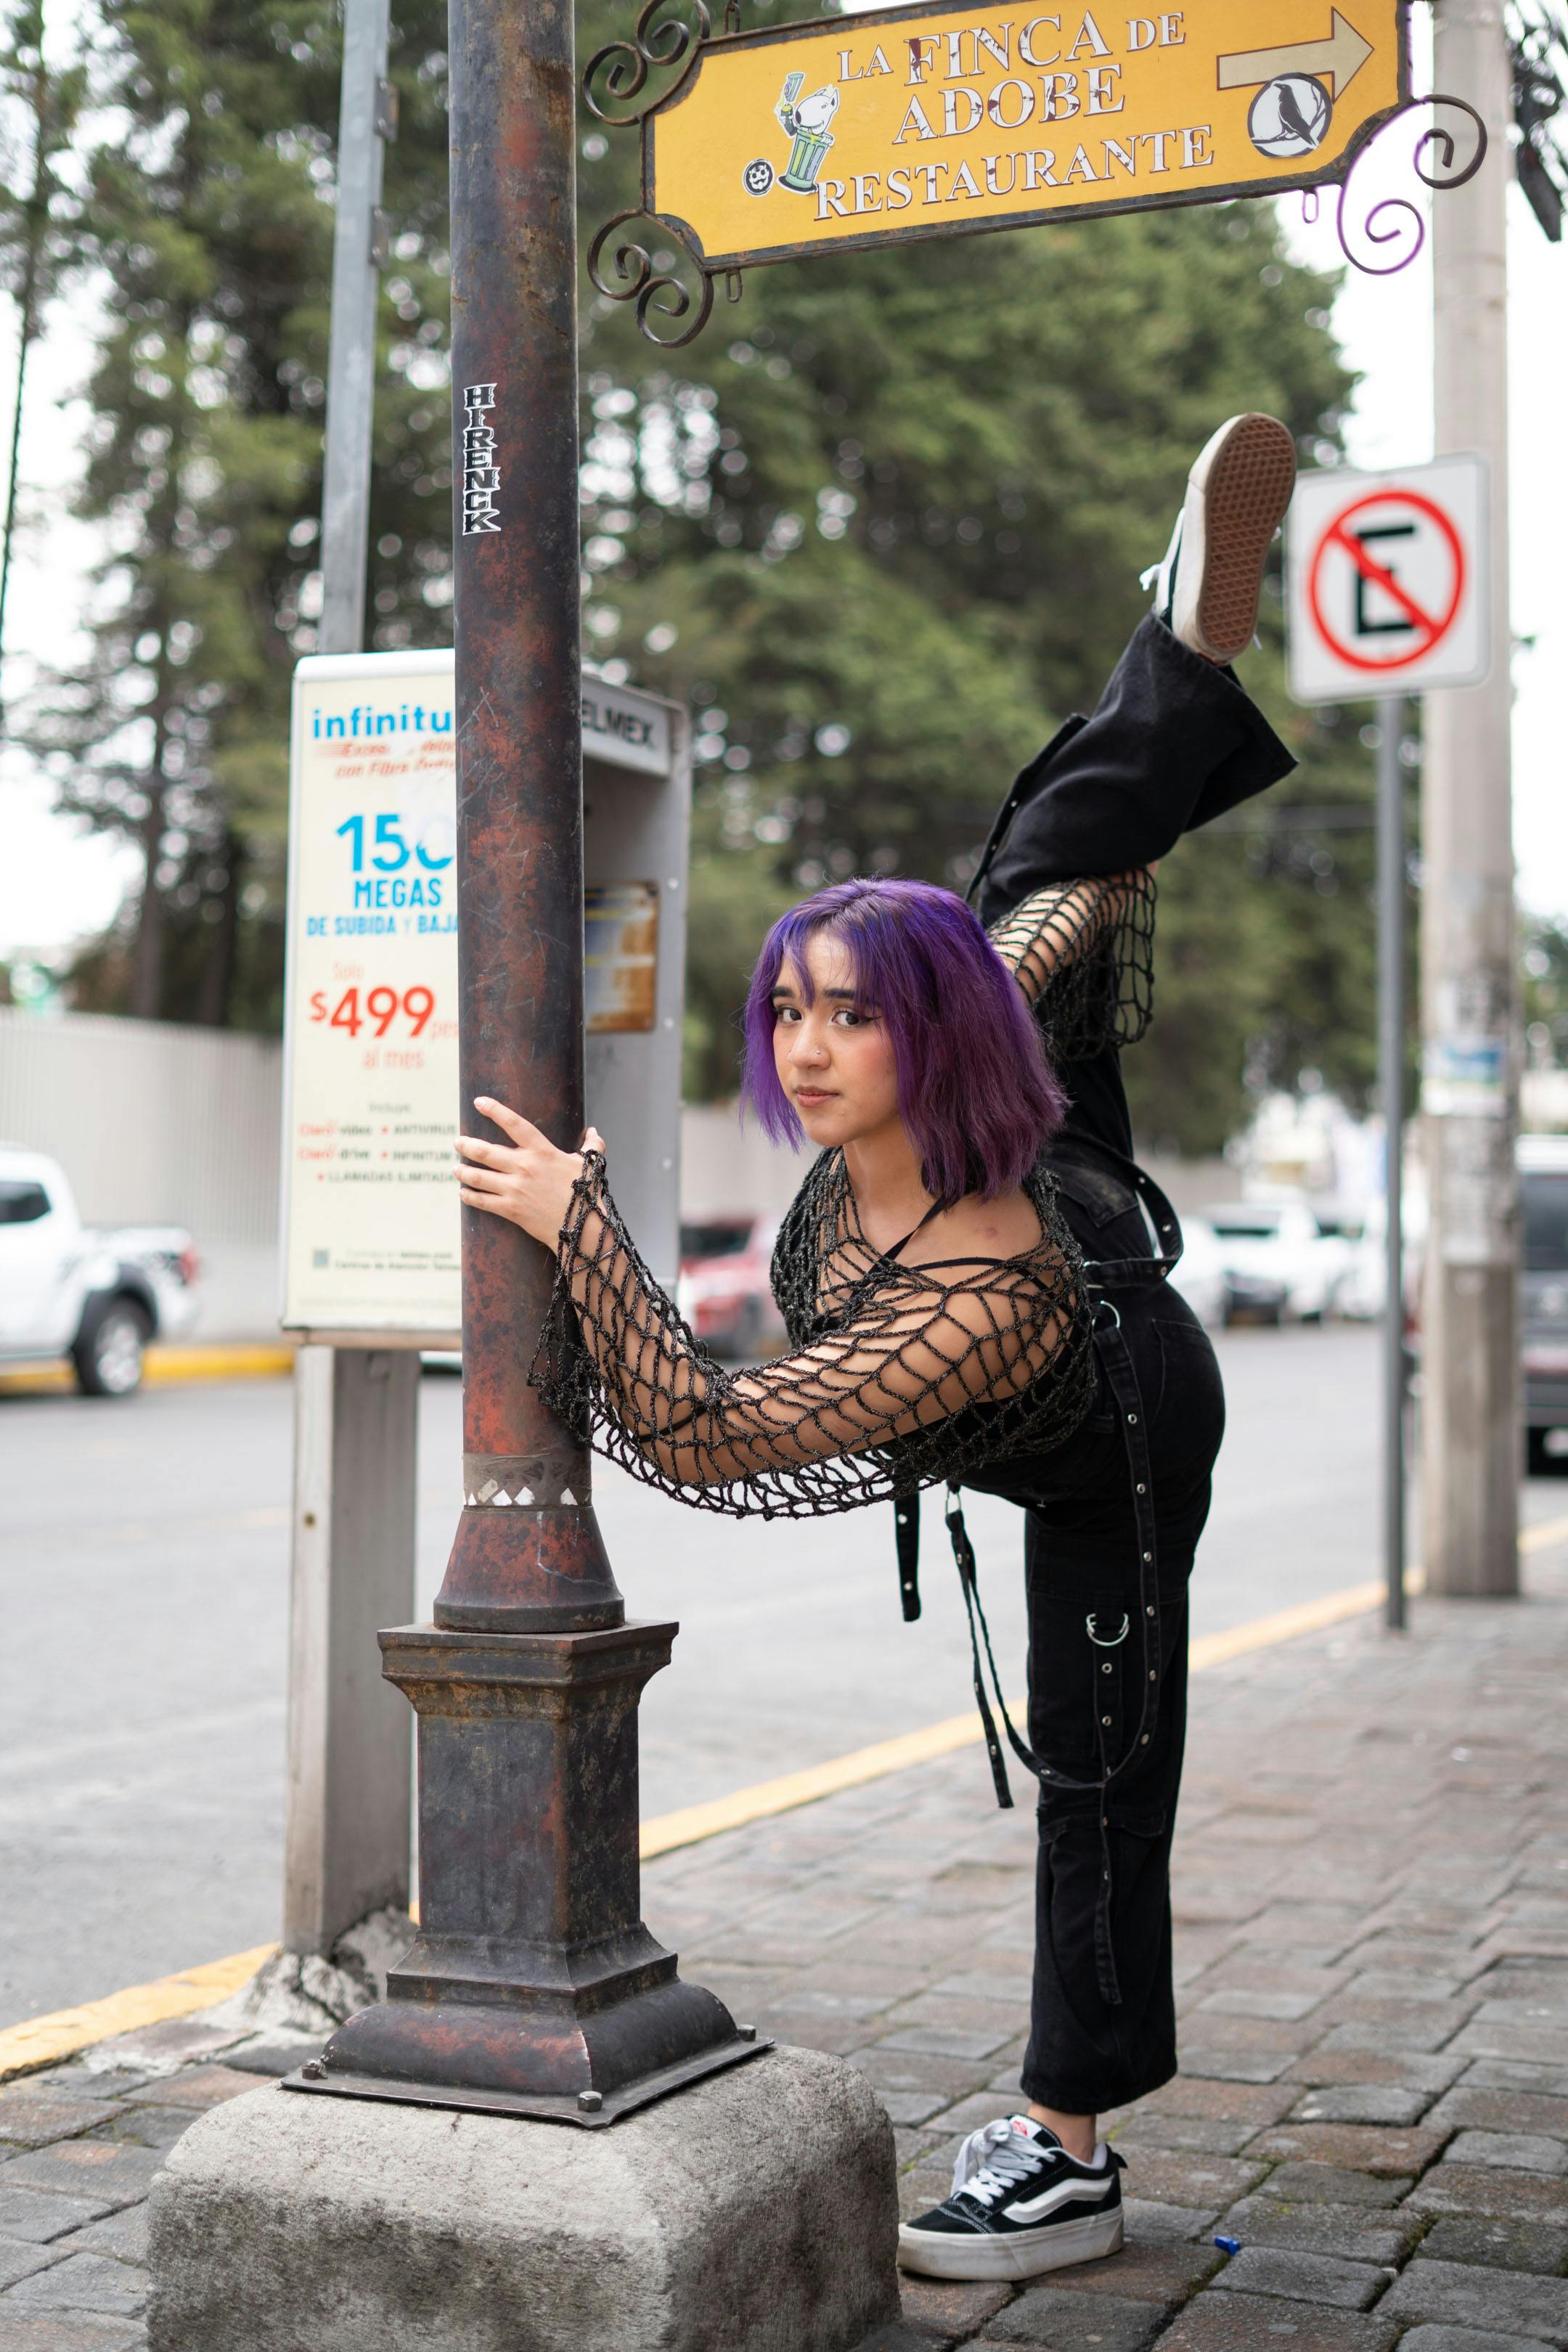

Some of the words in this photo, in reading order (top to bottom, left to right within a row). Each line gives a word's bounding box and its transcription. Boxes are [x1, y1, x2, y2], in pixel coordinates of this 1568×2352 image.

[838, 44, 894, 83] LA
[904, 9, 1114, 86] FINCA
[1126, 12, 1186, 53] DE
[892, 63, 1125, 145] ADOBE
[814, 124, 1215, 221] RESTAURANTE
[313, 703, 451, 738] infinitu
[581, 699, 656, 751] ELMEX
[354, 878, 442, 908] MEGAS
[306, 917, 327, 936] DE
[335, 915, 396, 935] SUBIDA
[417, 915, 458, 934] BAJA
[310, 985, 436, 1039] $499
